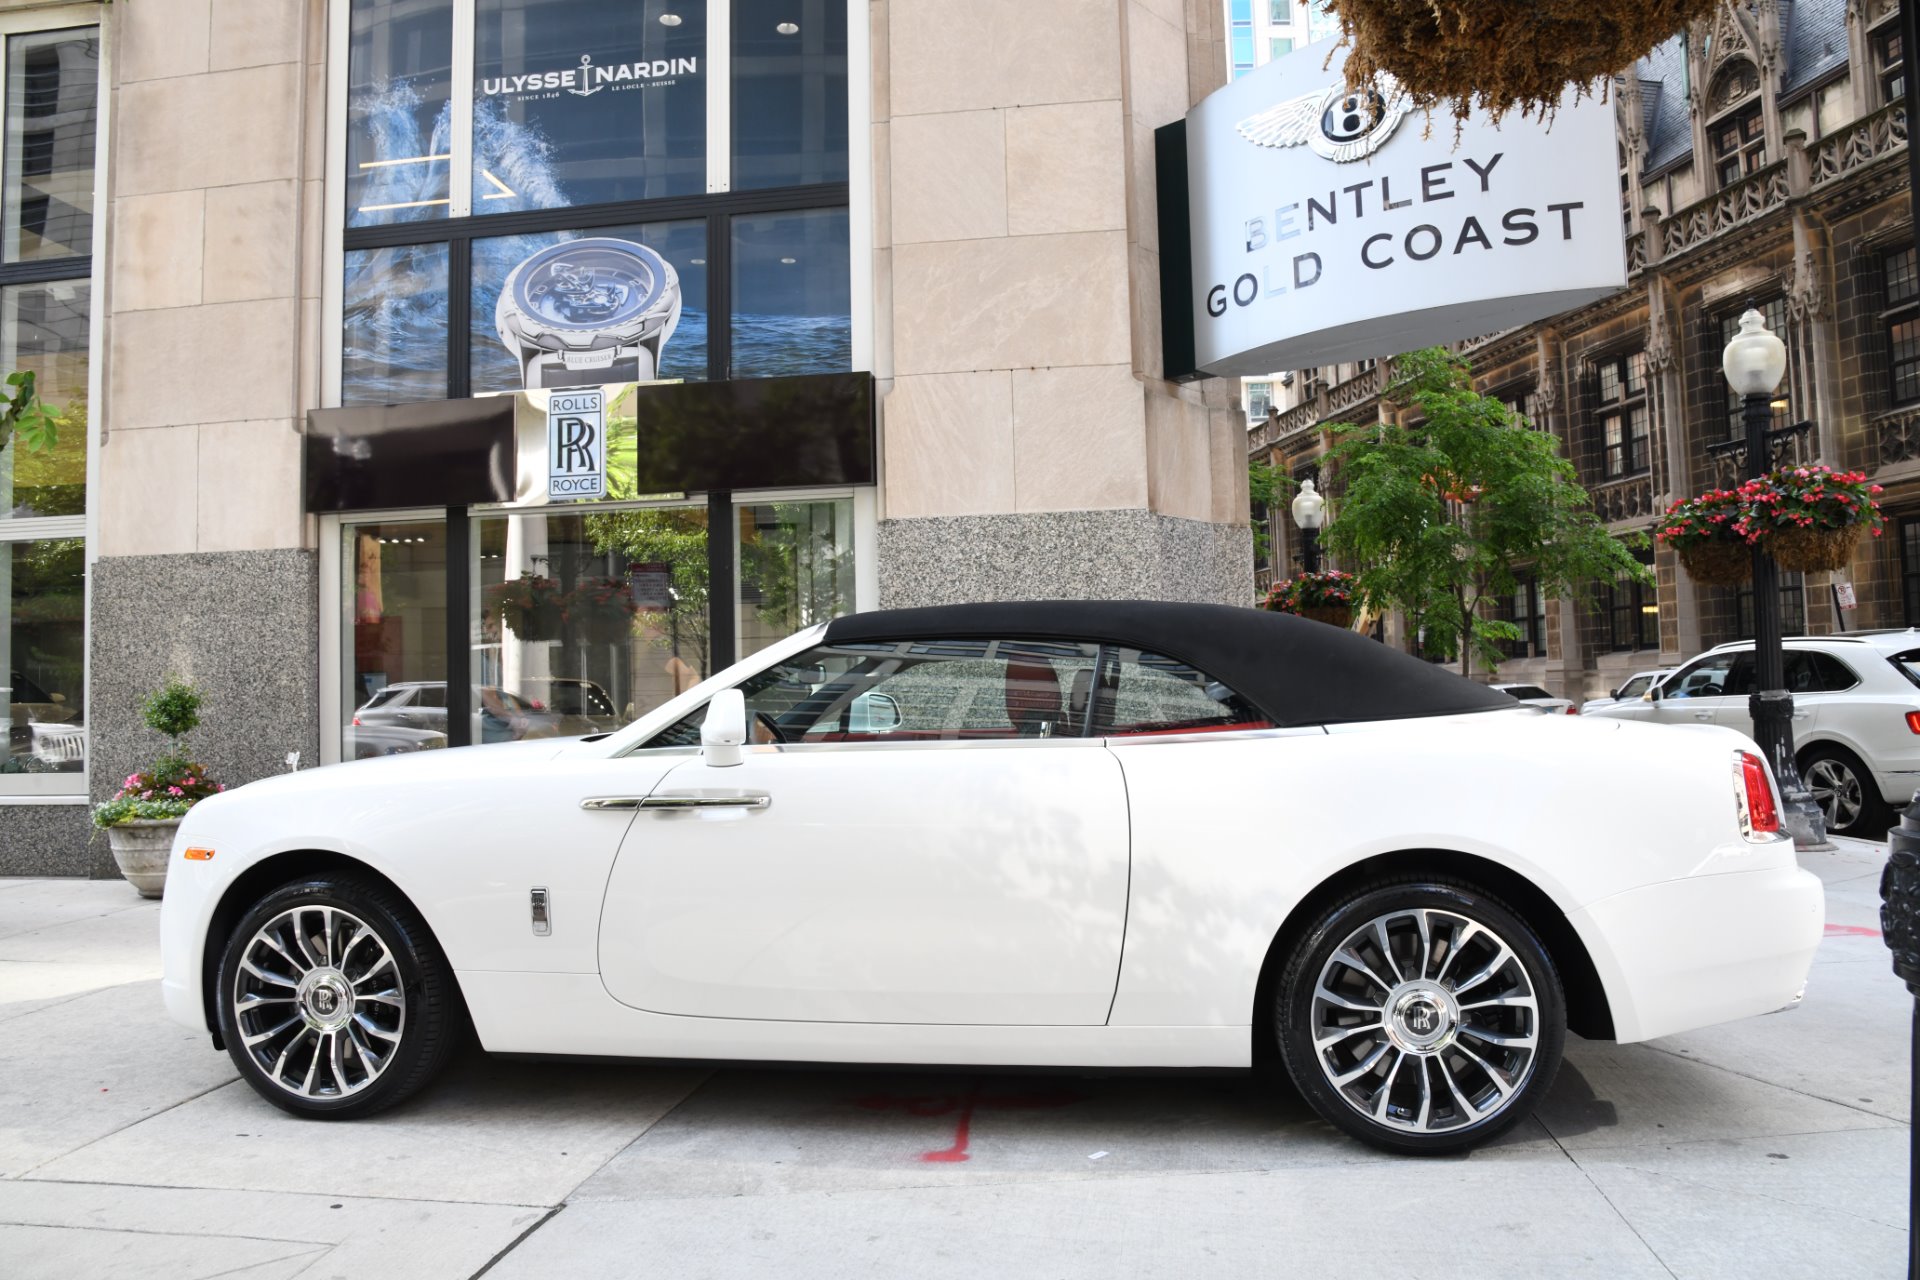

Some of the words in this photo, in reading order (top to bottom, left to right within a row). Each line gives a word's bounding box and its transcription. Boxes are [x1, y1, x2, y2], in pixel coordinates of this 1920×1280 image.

[484, 69, 576, 96] ULYSSE
[596, 56, 697, 84] NARDIN
[622, 83, 645, 91] LOCLE
[652, 79, 676, 87] SUISSE
[517, 94, 539, 102] SINCE
[542, 91, 560, 99] 1846
[1245, 152, 1504, 253] BENTLEY
[1206, 251, 1323, 318] GOLD
[1361, 201, 1584, 270] COAST
[553, 397, 598, 411] ROLLS
[556, 417, 595, 473] RR
[553, 477, 598, 491] ROYCE
